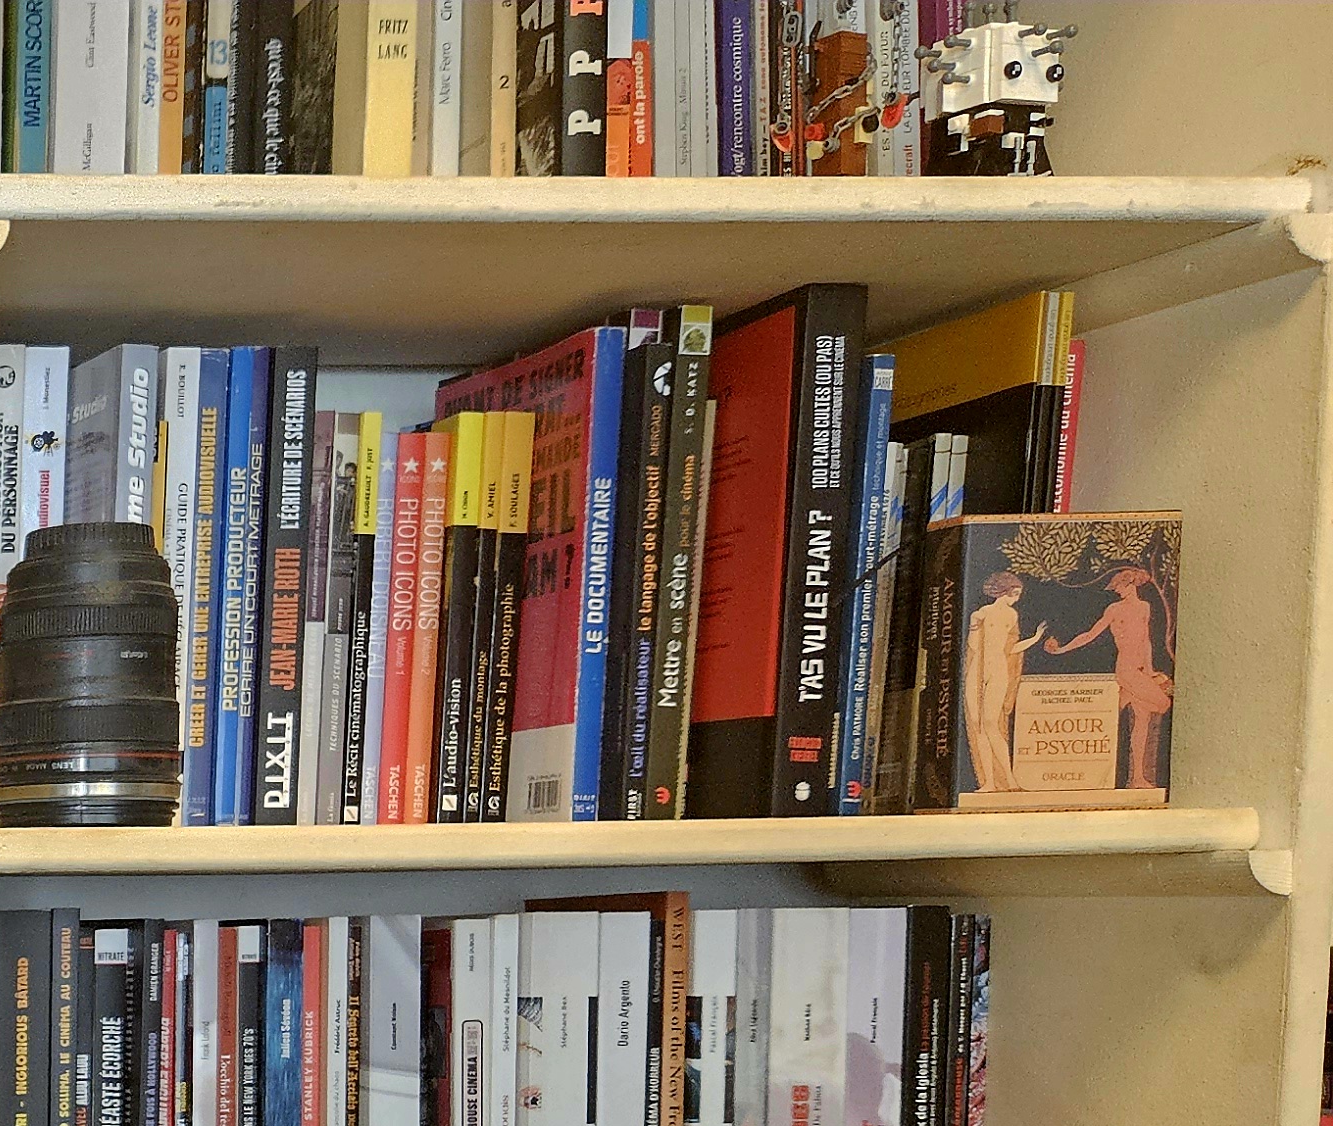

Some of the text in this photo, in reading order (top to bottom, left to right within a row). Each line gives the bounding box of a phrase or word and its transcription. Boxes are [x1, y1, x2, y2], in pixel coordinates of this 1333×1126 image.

[162, 31, 179, 103] OLIVER
[210, 40, 227, 66] 13
[377, 44, 407, 59] LANG
[378, 18, 408, 35] FRITZ
[23, 50, 40, 128] MARTIN
[128, 368, 149, 469] Studio
[277, 370, 307, 529] L'ÉCRITURE SCÉNARIOS
[812, 387, 831, 489] 100 PLANS CULTES
[1, 425, 18, 553] DU PERSONNAGE
[196, 407, 217, 603] ENTREPRISE AUDIOVISUELLE
[223, 467, 246, 711] PROFESSION PRODUCTEUR
[392, 498, 419, 631] PHOTO ICONS
[584, 476, 612, 654] LE DOCUMENTAIRE
[802, 530, 831, 651] VU LE PLAN
[270, 547, 300, 690] JEAN-MARIE ROTH
[659, 552, 688, 707] Mettre scène
[442, 678, 462, 788] L'audio-vision
[489, 583, 514, 791] Esthétique photographie
[1028, 718, 1104, 734] AMOUR
[263, 711, 286, 809] DIXIT
[387, 764, 400, 819] TASCHEN
[413, 764, 425, 818] TASCHEN
[1035, 735, 1110, 755] PSYCHÉ
[98, 1017, 121, 1078] ÉCORCHÉ
[618, 980, 631, 1046] Dario Argento
[303, 1011, 314, 1120] STANLEY KUBRICK
[467, 1056, 478, 1095] CINEMA
